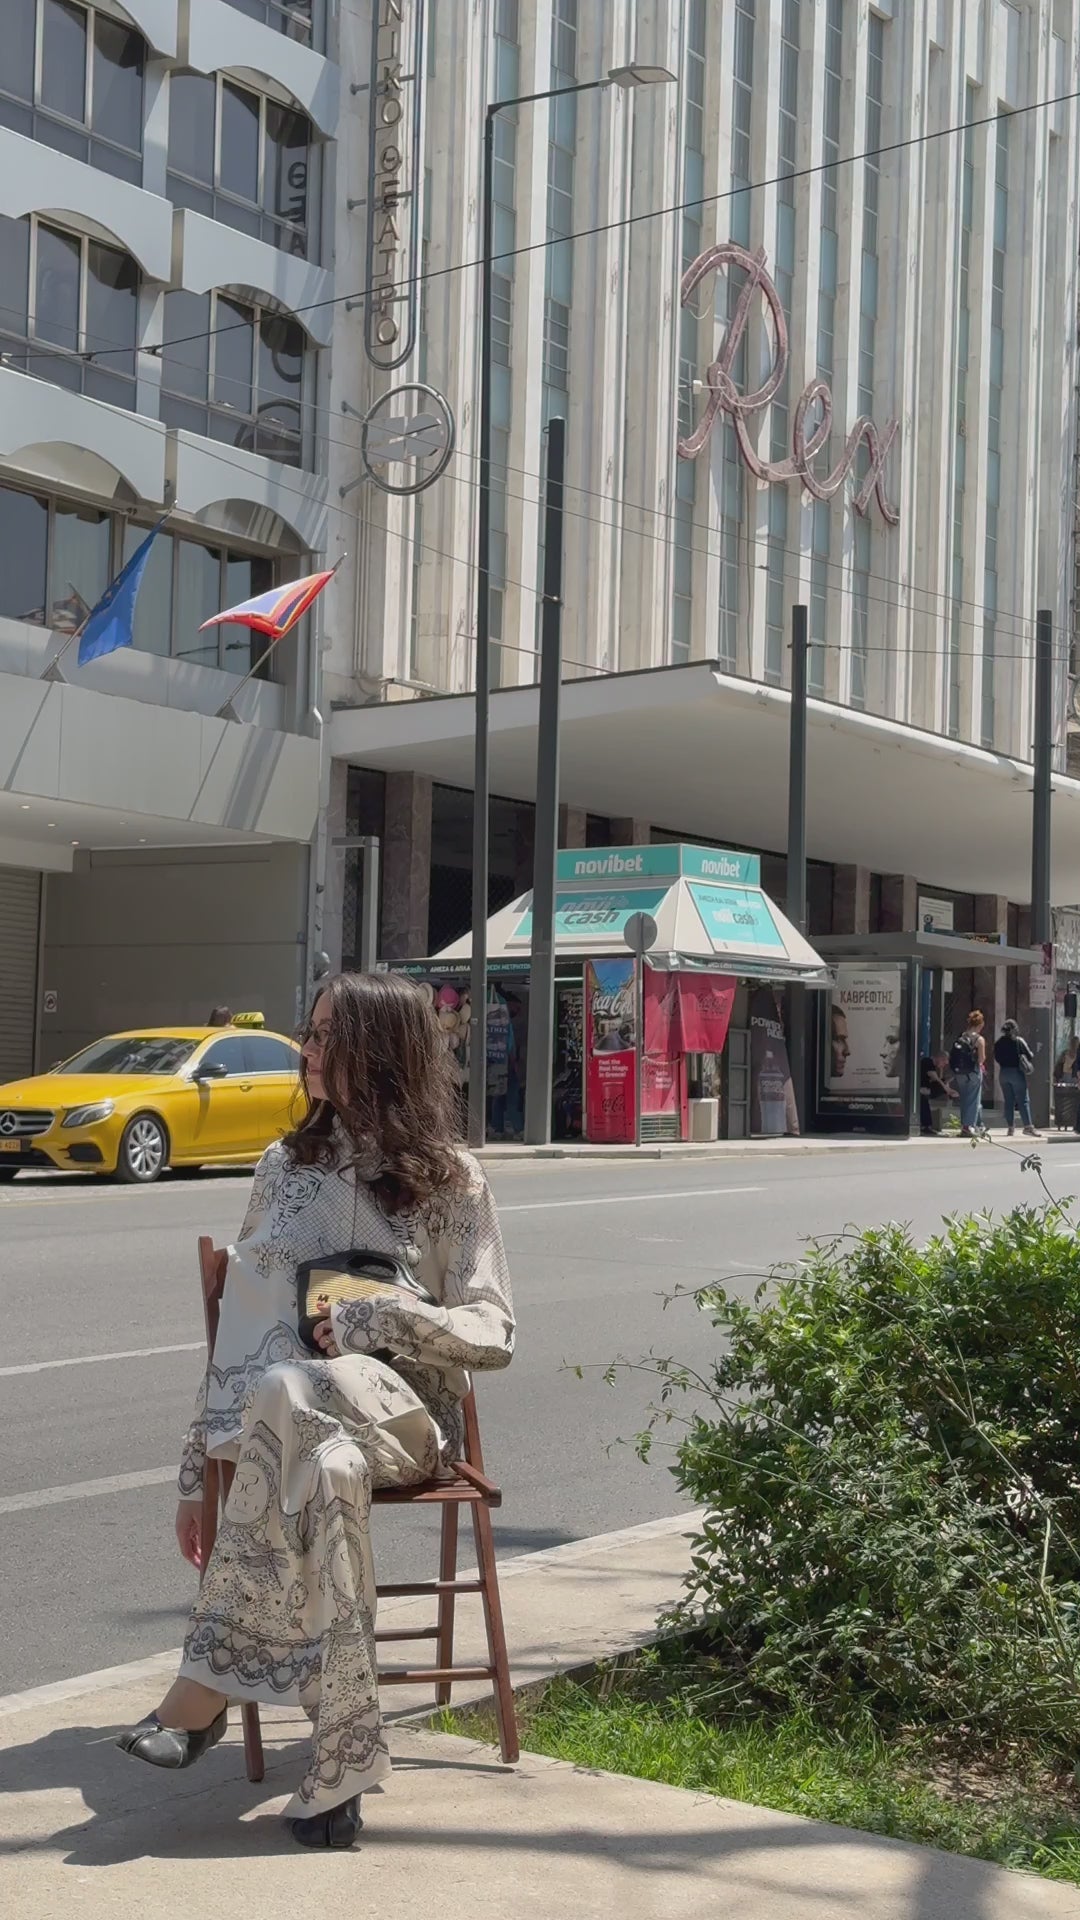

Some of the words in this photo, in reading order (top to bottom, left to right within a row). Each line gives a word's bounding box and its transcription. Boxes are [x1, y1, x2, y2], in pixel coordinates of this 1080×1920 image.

[678, 243, 900, 526] Rex
[576, 854, 643, 875] novibet
[701, 856, 740, 878] novibet
[564, 909, 620, 924] cash
[840, 990, 894, 1004] ΚΑΘΡΕΦΤΗΣ
